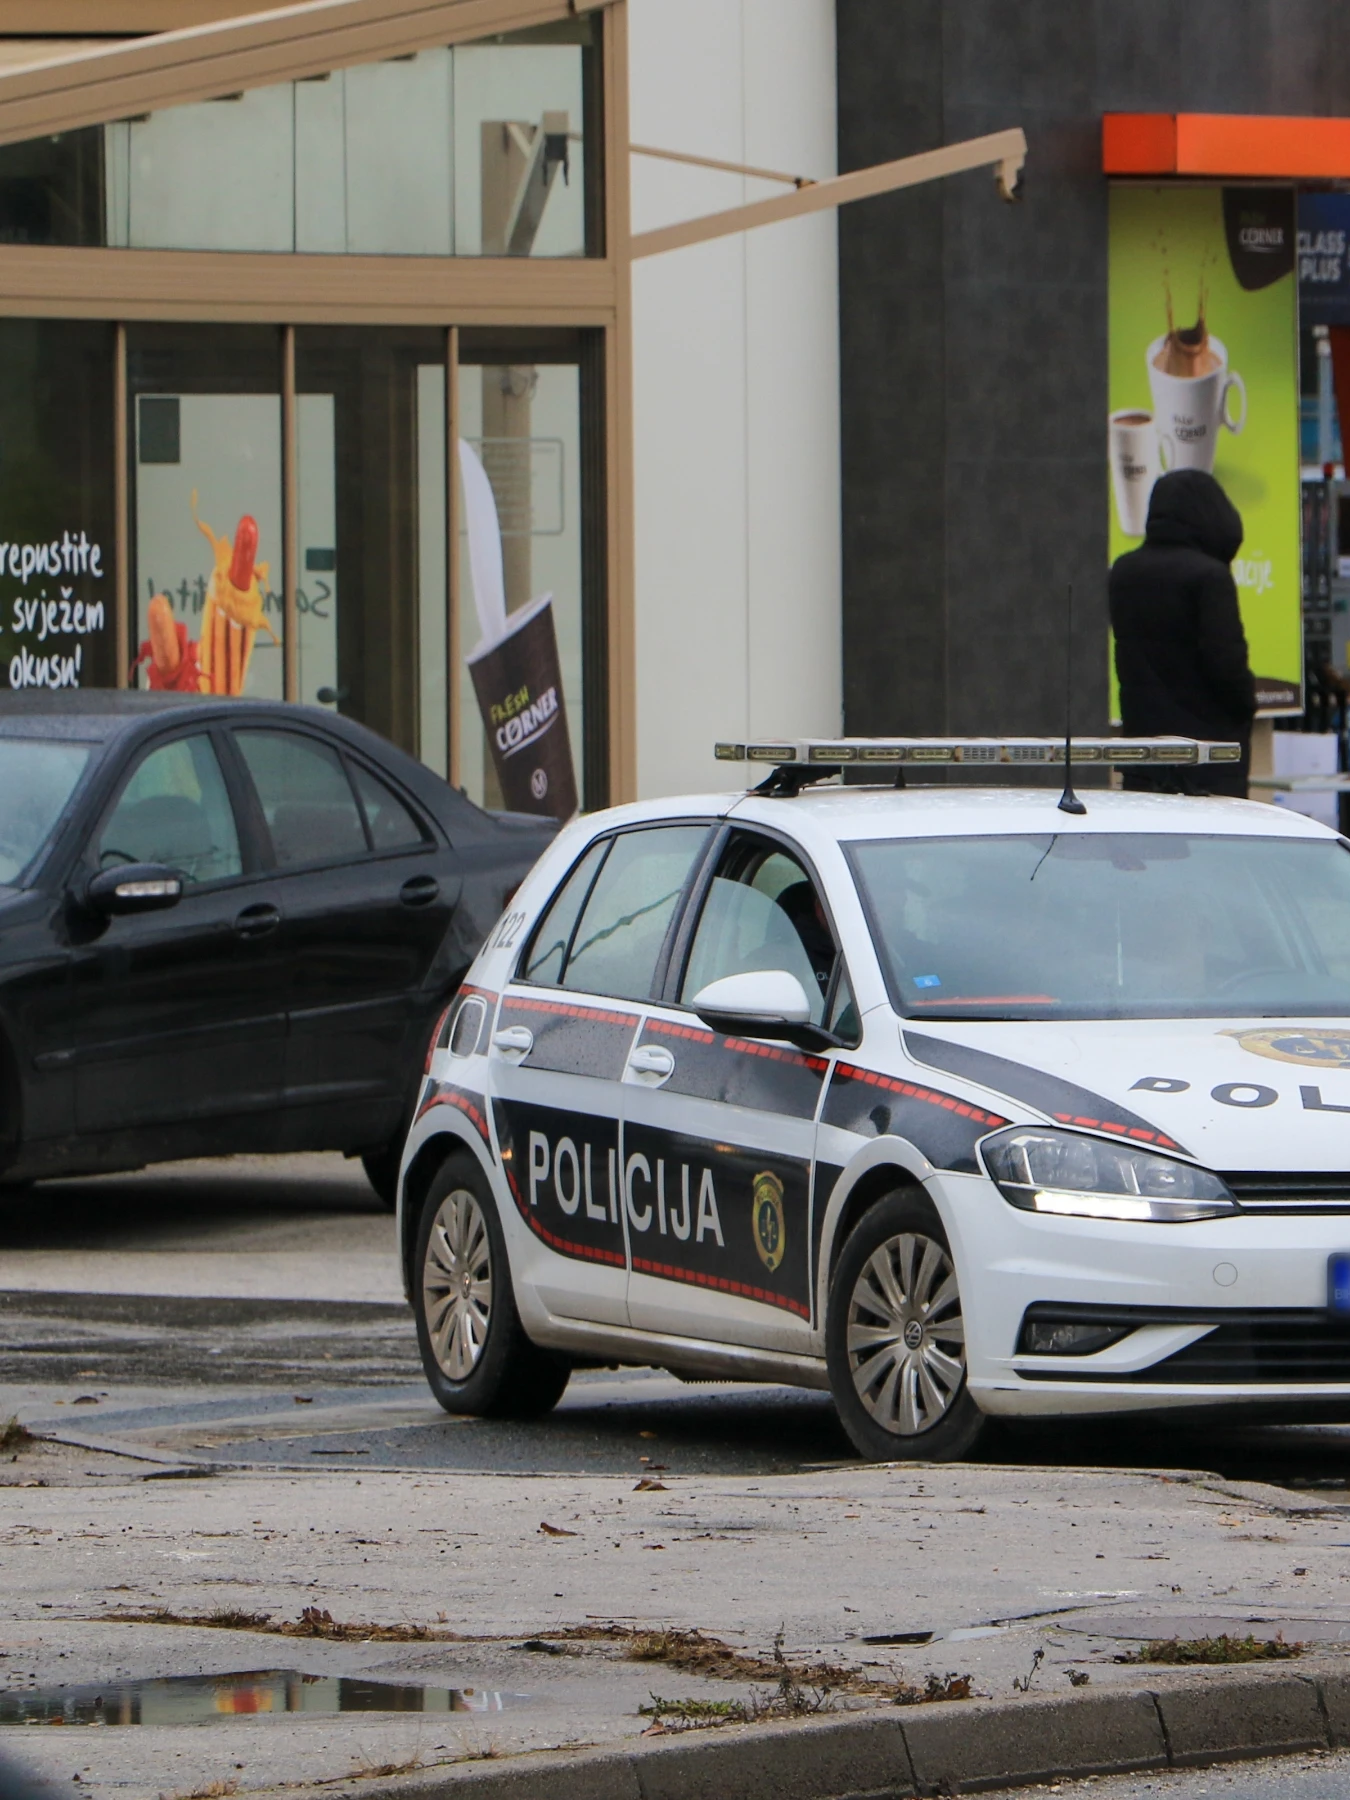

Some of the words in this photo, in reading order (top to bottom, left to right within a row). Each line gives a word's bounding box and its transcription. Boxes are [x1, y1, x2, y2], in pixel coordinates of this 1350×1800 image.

[1301, 256, 1341, 282] PLUS
[12, 586, 105, 641] svježem
[496, 686, 559, 752] CORNER
[492, 911, 526, 949] 122
[529, 1129, 725, 1247] POLICIJA
